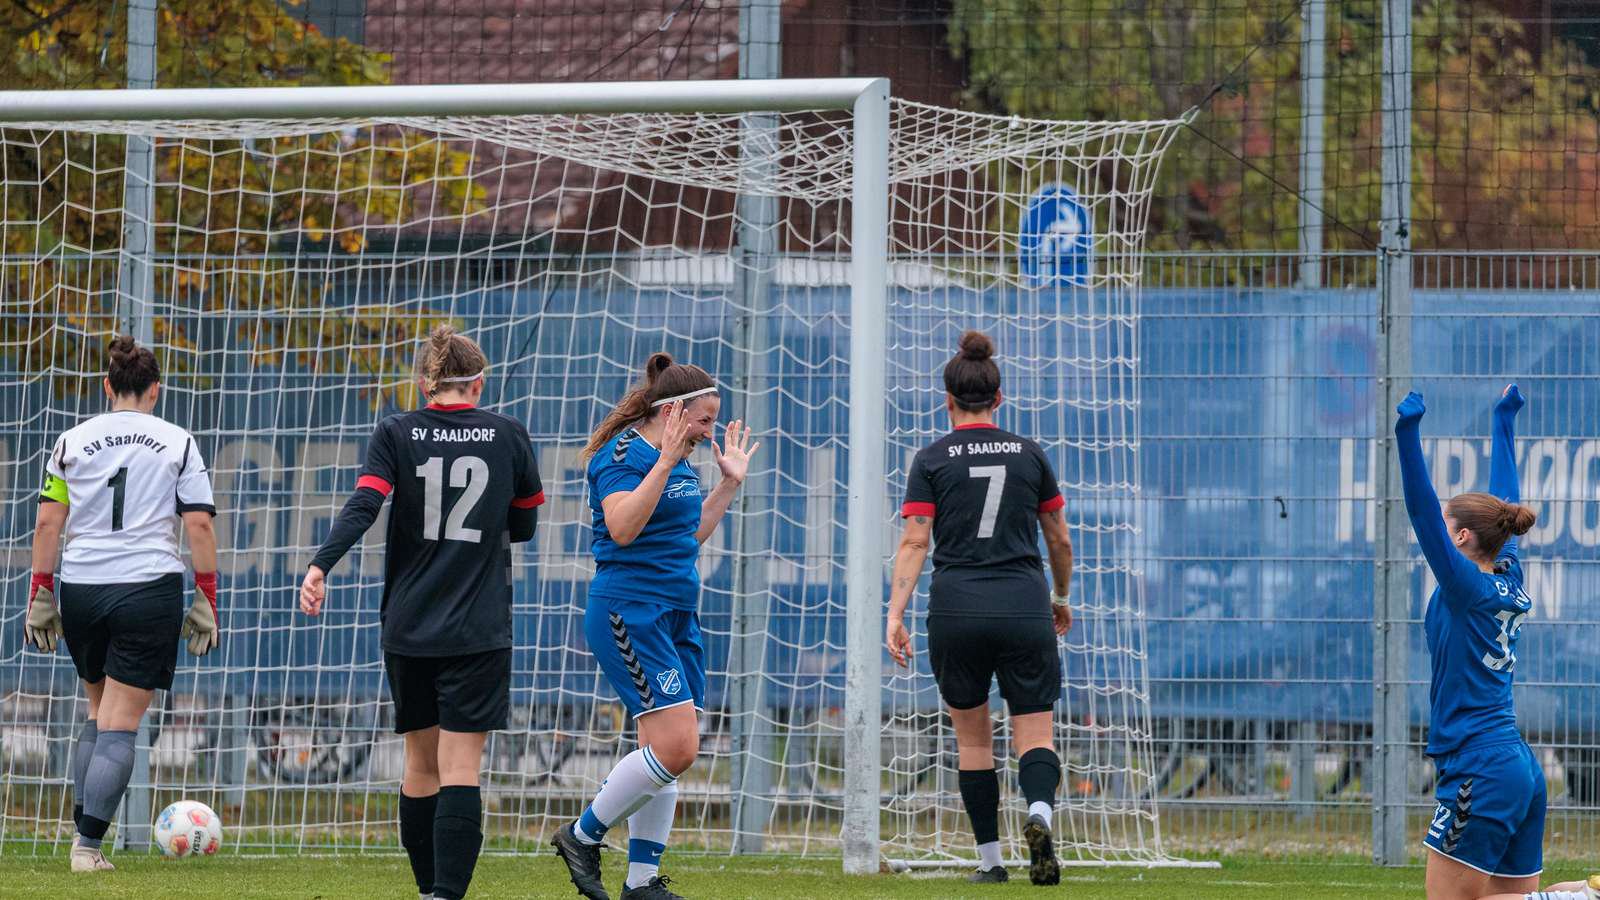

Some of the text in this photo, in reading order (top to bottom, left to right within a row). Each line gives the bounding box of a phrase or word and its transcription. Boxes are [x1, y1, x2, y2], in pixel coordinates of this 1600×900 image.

[83, 432, 168, 456] SV Saaldorf
[411, 427, 496, 442] SV SAALDORF
[948, 441, 1023, 457] SV SAALDORF
[107, 467, 128, 532] 1
[416, 455, 490, 543] 12
[969, 465, 1007, 539] 7
